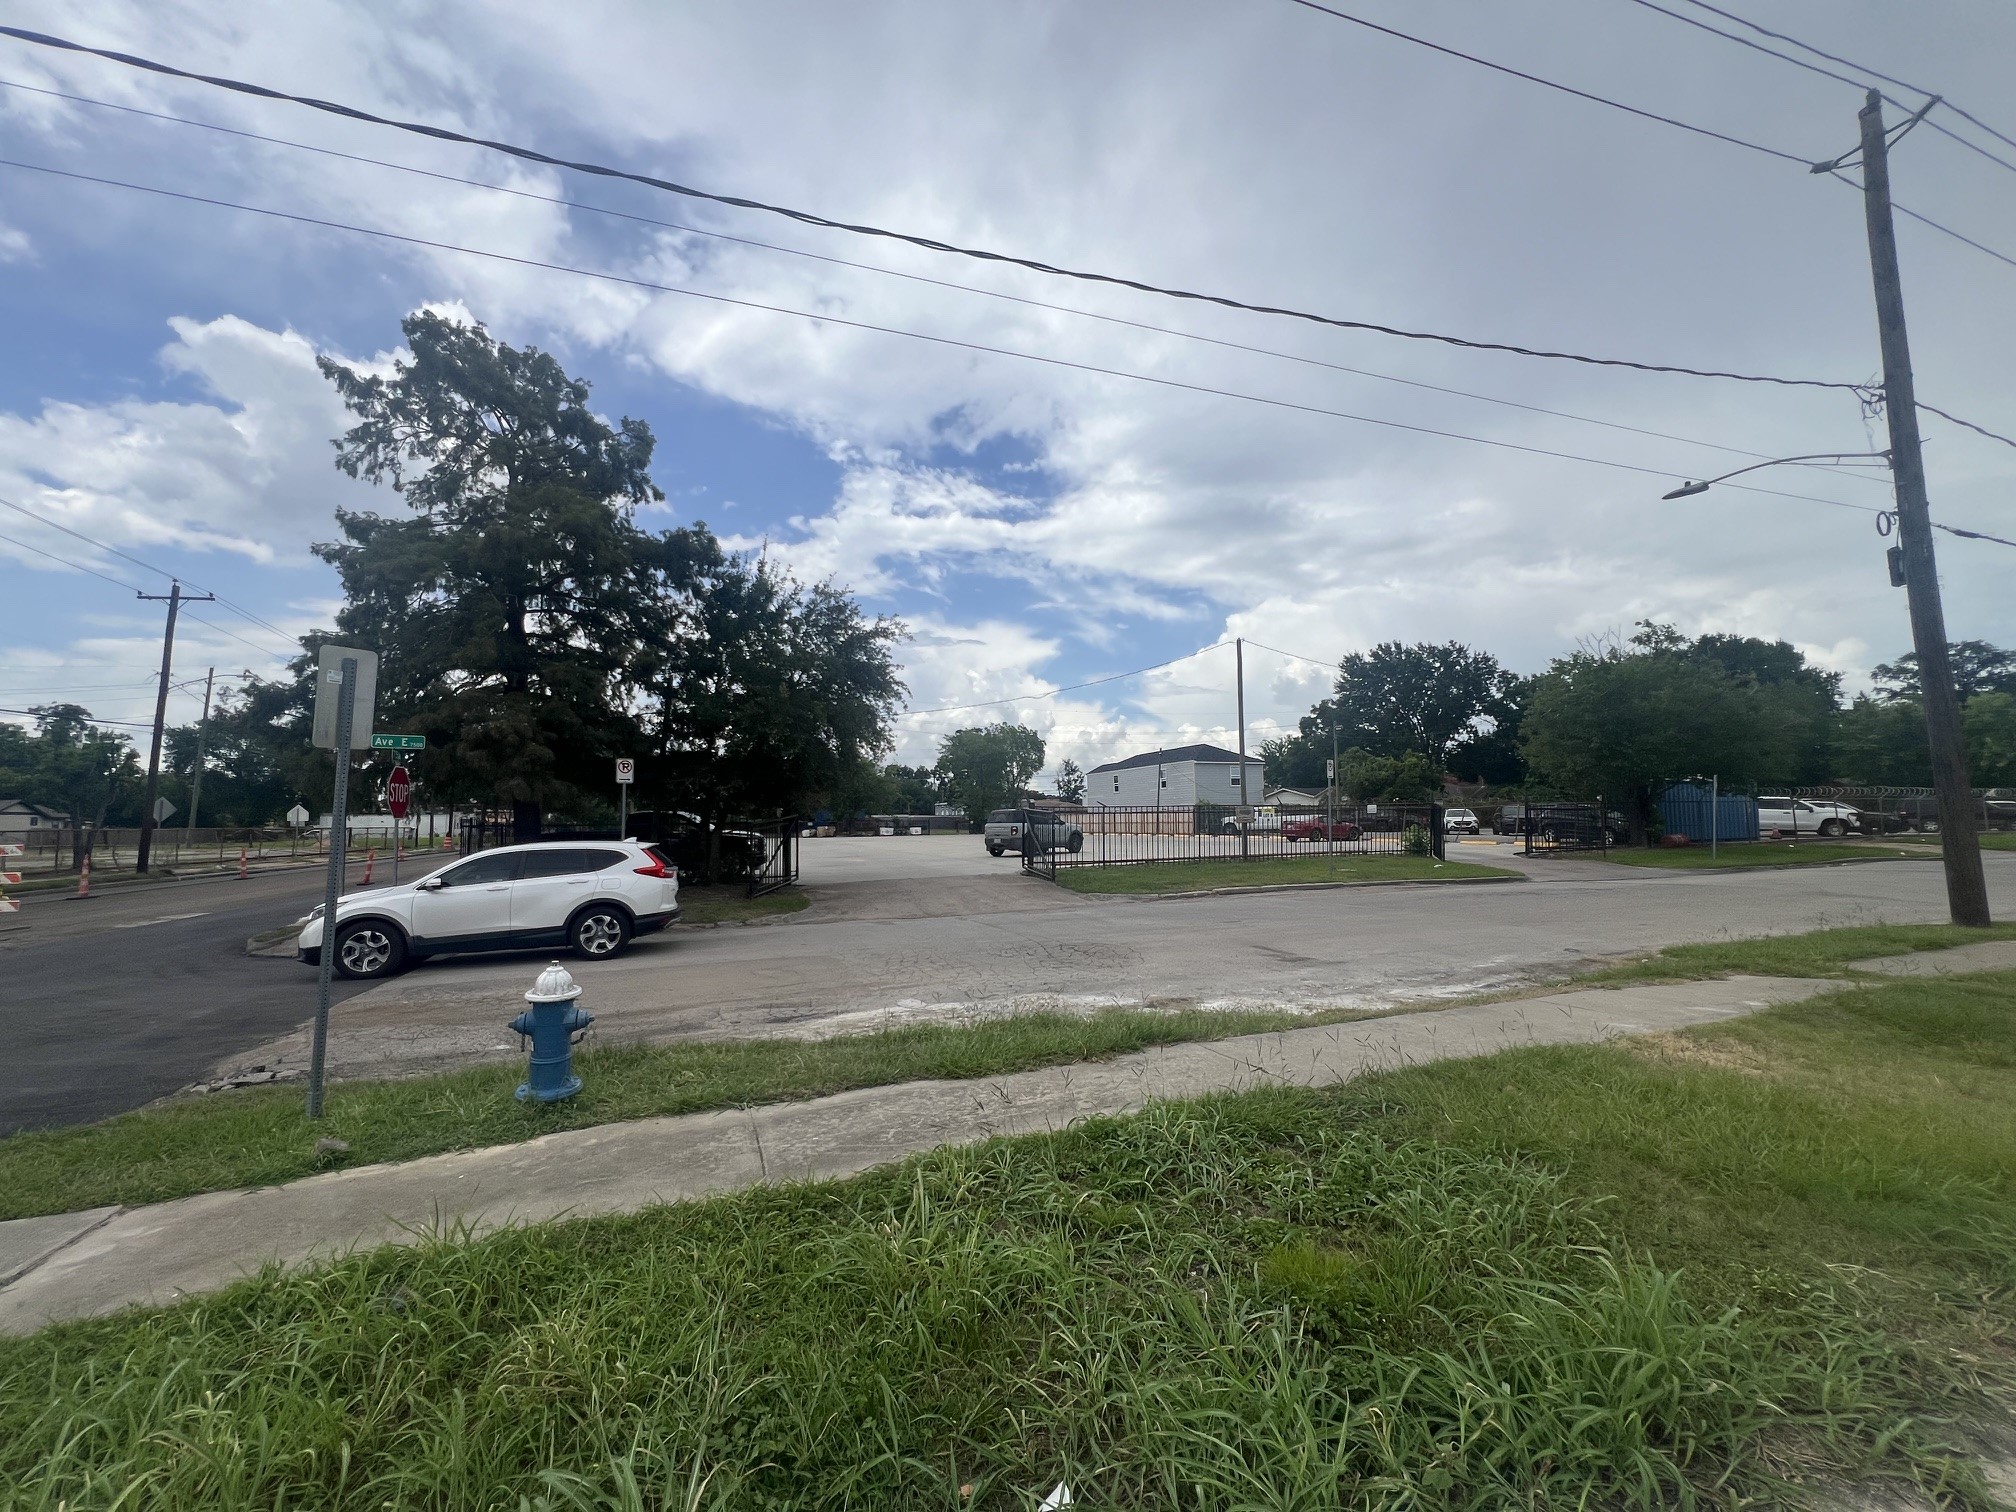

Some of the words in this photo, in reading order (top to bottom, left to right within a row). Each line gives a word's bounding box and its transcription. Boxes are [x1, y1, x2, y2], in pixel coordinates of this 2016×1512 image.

[374, 737, 394, 746] Ave
[401, 737, 408, 747] E
[389, 783, 409, 802] STOP
